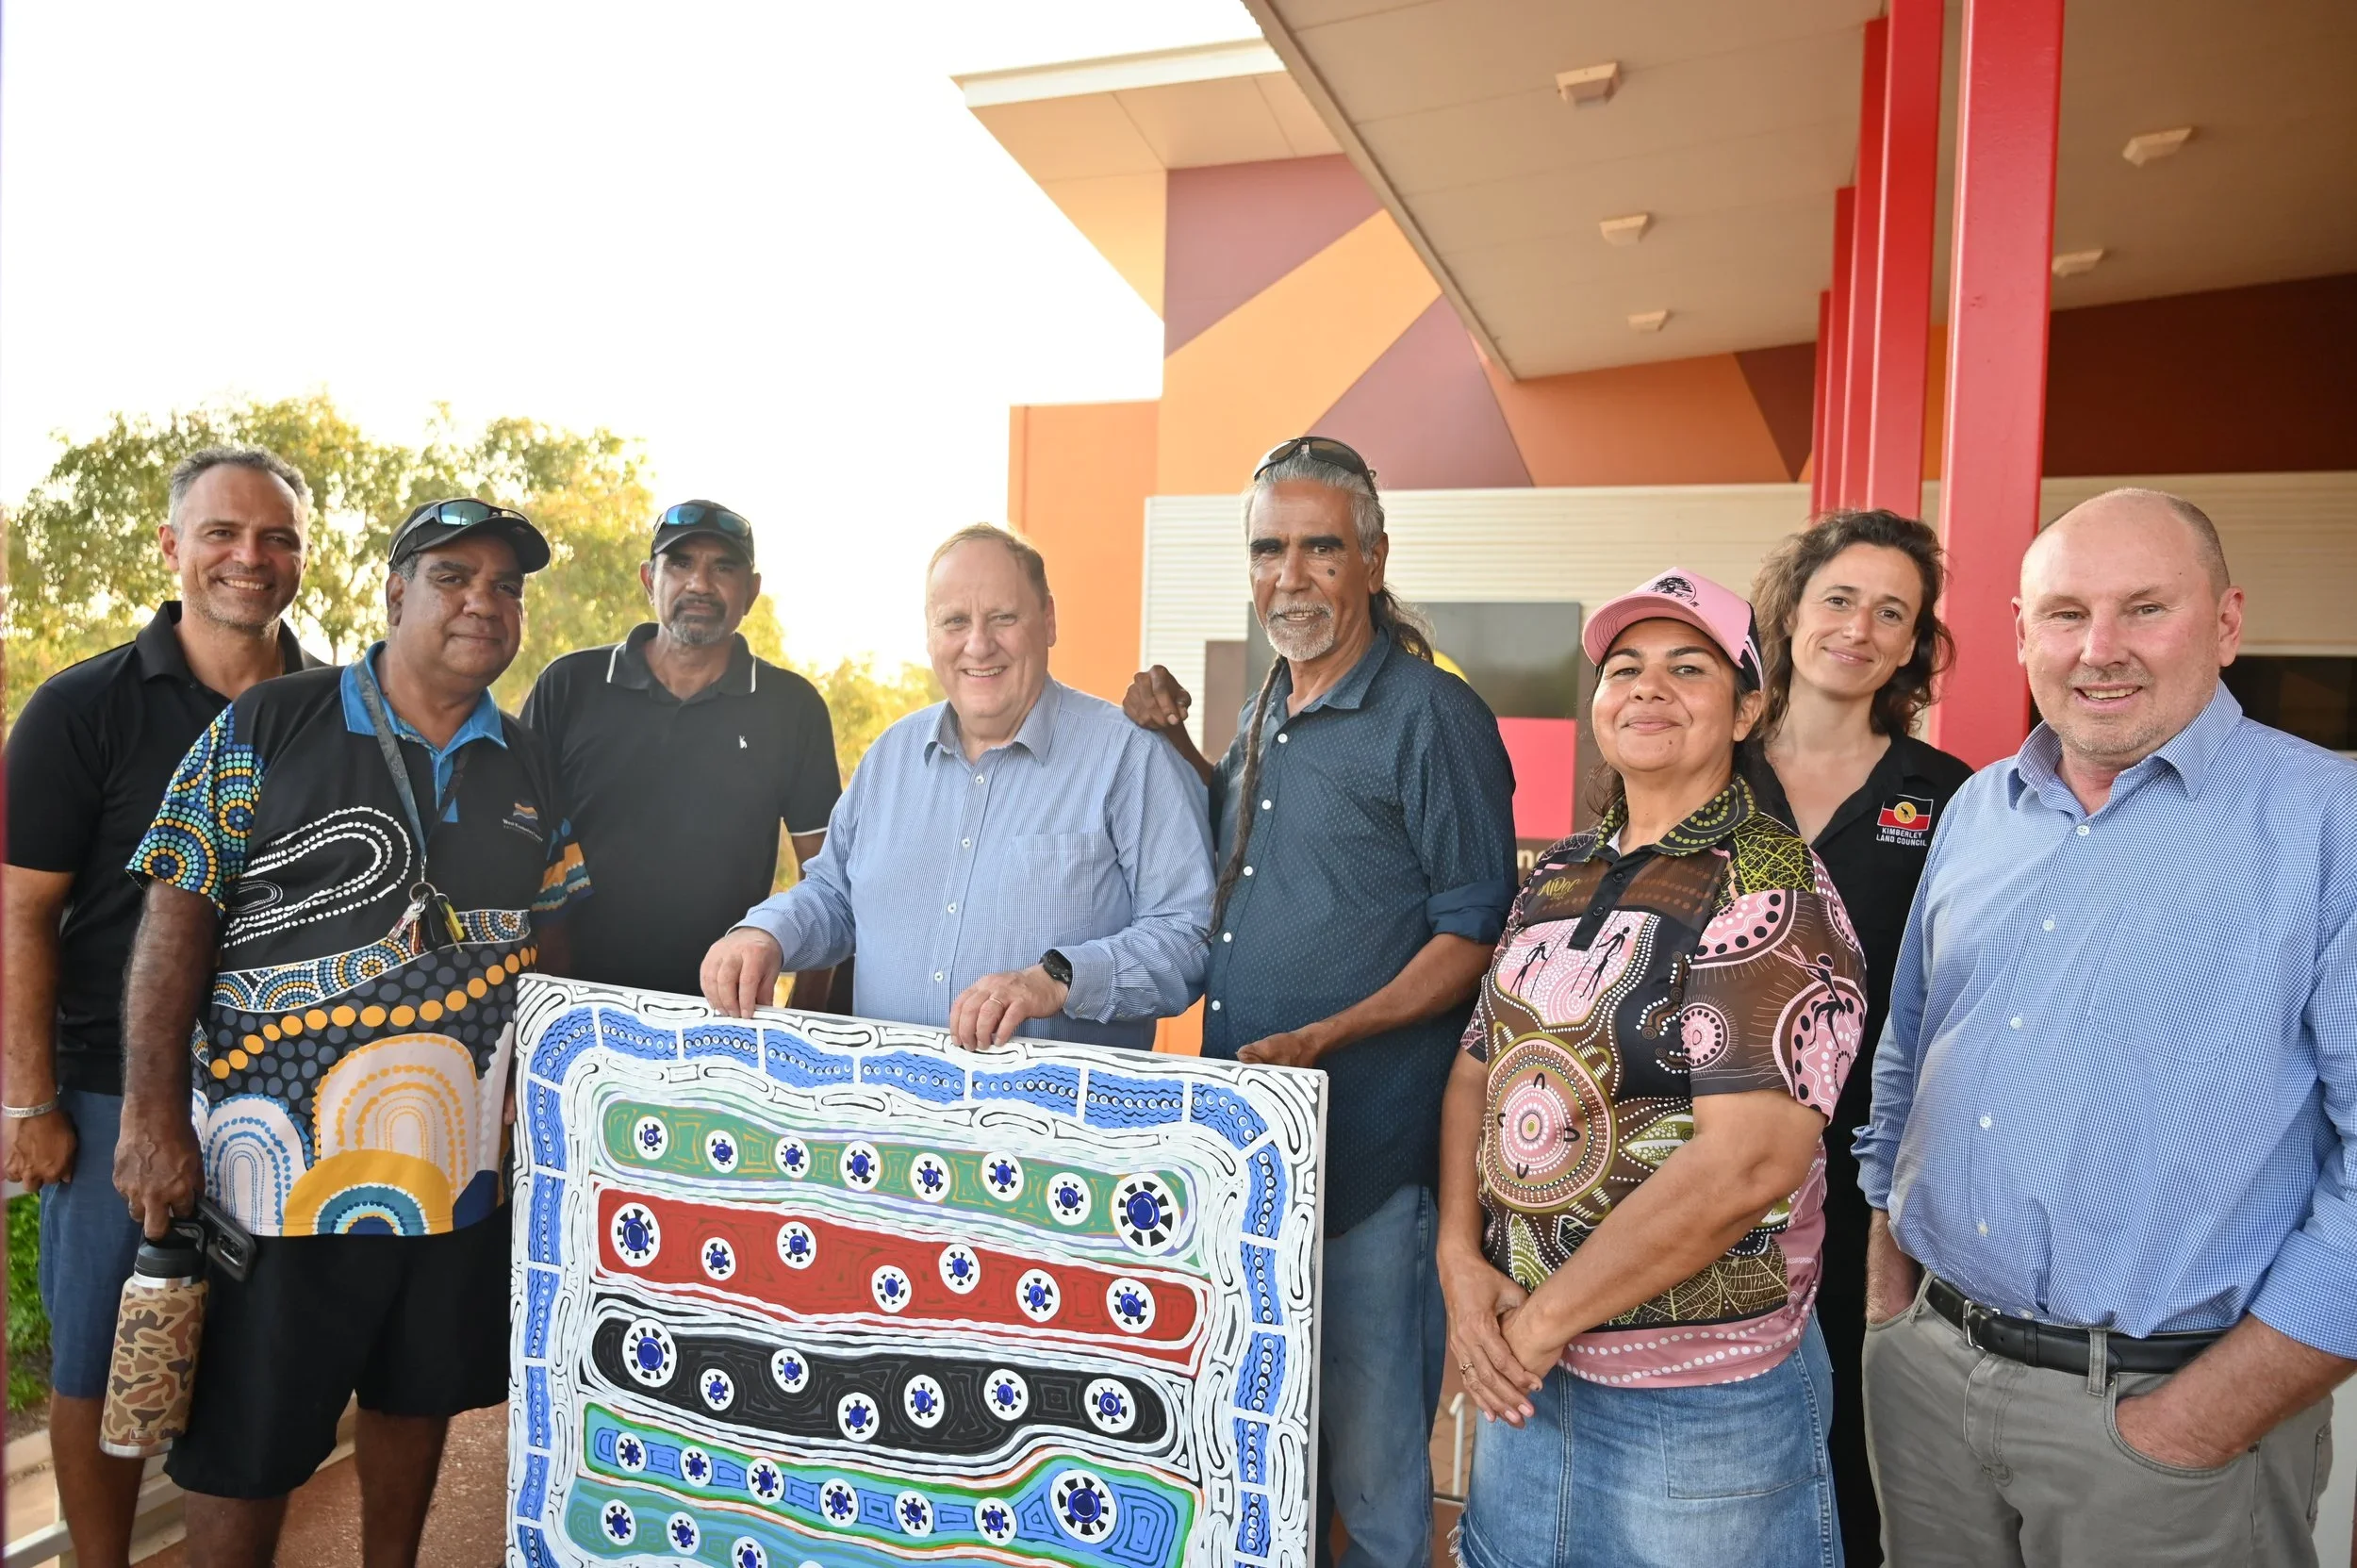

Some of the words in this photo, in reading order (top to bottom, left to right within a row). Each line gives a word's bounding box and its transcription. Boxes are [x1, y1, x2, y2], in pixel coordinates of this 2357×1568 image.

[1882, 827, 1922, 839] KIMBERLEY
[1876, 834, 1895, 843] LAND
[1896, 837, 1927, 847] COUNCIL
